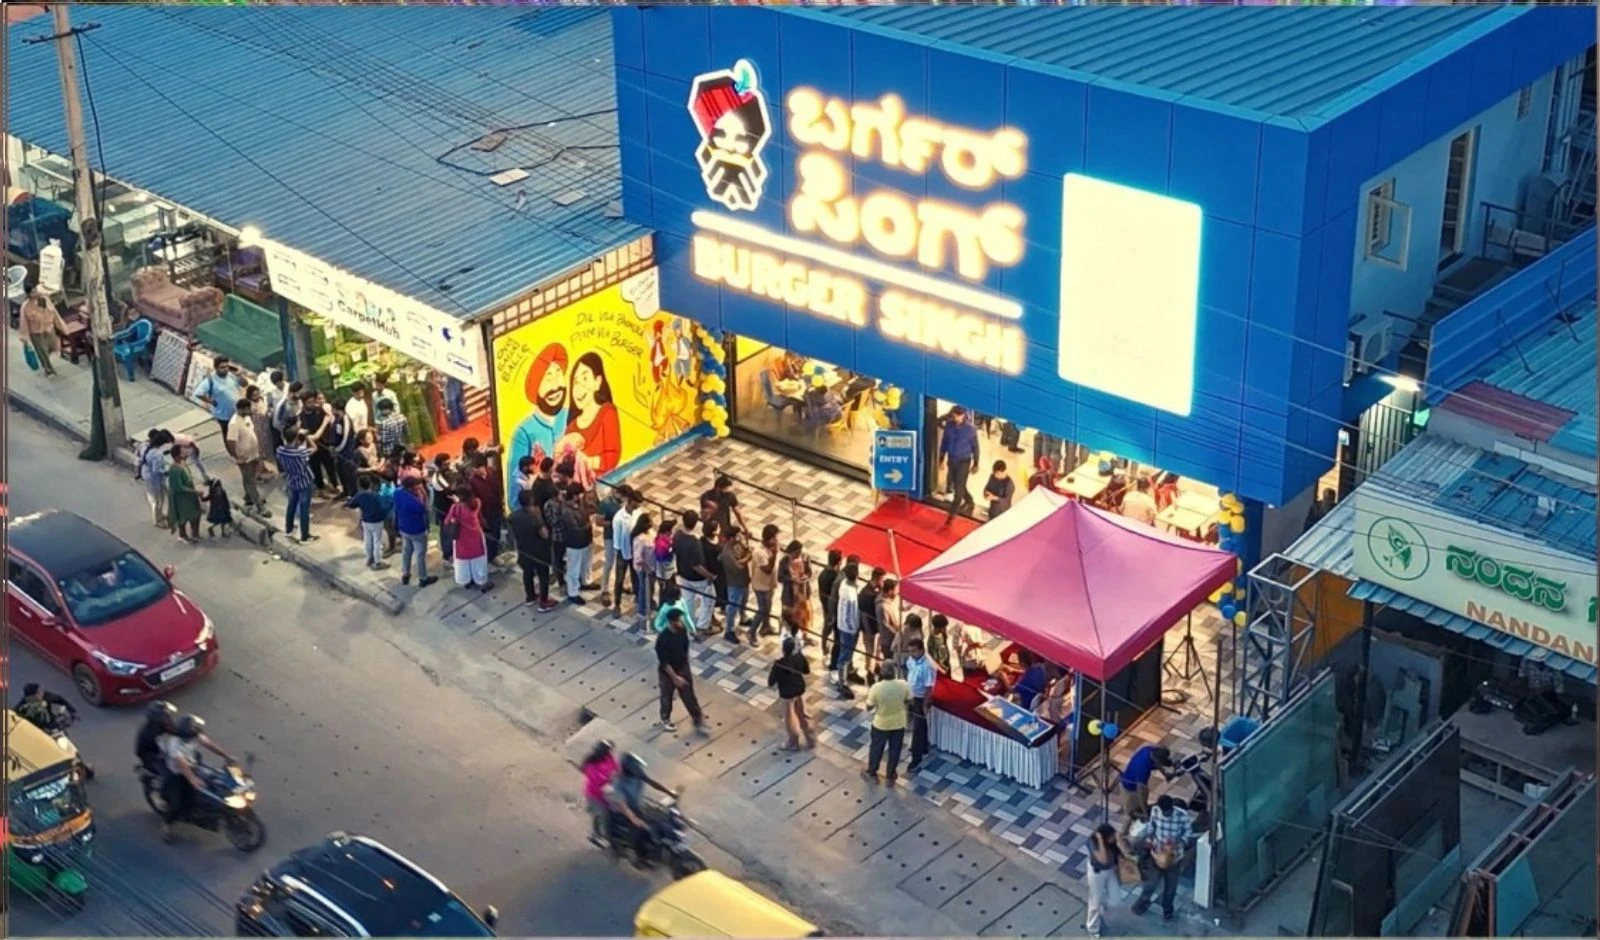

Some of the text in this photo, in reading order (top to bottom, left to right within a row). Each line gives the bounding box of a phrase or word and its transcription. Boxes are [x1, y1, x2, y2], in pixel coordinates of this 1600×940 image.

[790, 152, 1024, 281] ಸಿಂಗ್
[693, 235, 1025, 376] BURGER SINGH
[879, 454, 909, 464] ENTRY
[1445, 543, 1567, 613] ನಂದನ
[1466, 601, 1598, 665] NANDAN
